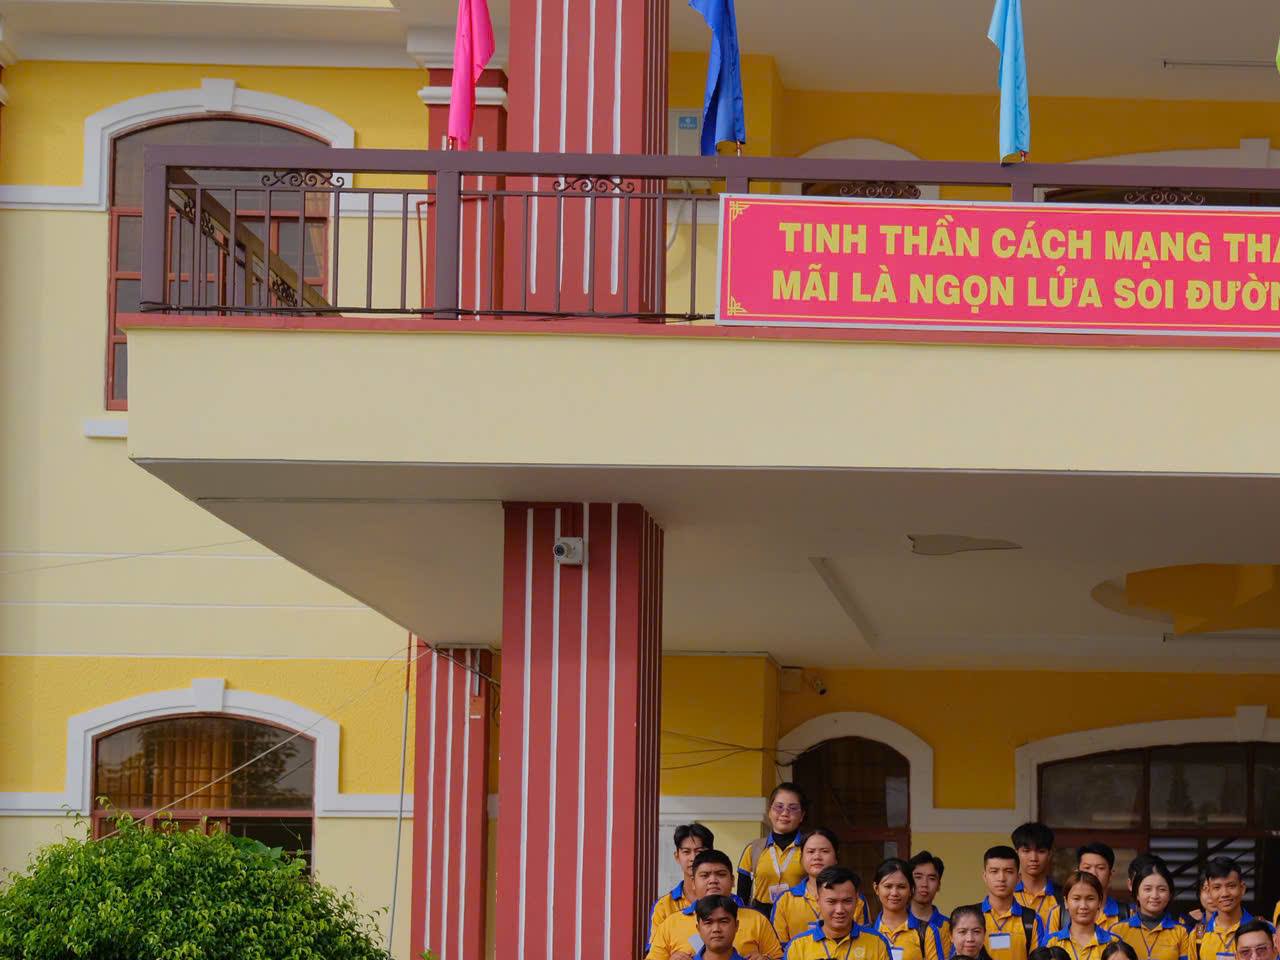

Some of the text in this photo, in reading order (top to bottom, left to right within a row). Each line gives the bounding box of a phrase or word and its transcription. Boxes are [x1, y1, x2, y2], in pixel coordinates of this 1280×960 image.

[779, 223, 866, 254] TINH
[880, 215, 979, 256] THẦN
[992, 221, 1091, 259] CÁCH
[1105, 231, 1210, 268] MẠNG
[773, 264, 838, 301] MÃI
[853, 265, 896, 302] LÀ
[910, 274, 1014, 313] NGỌN
[1028, 266, 1102, 307] LỬA
[1115, 278, 1173, 308] SOI
